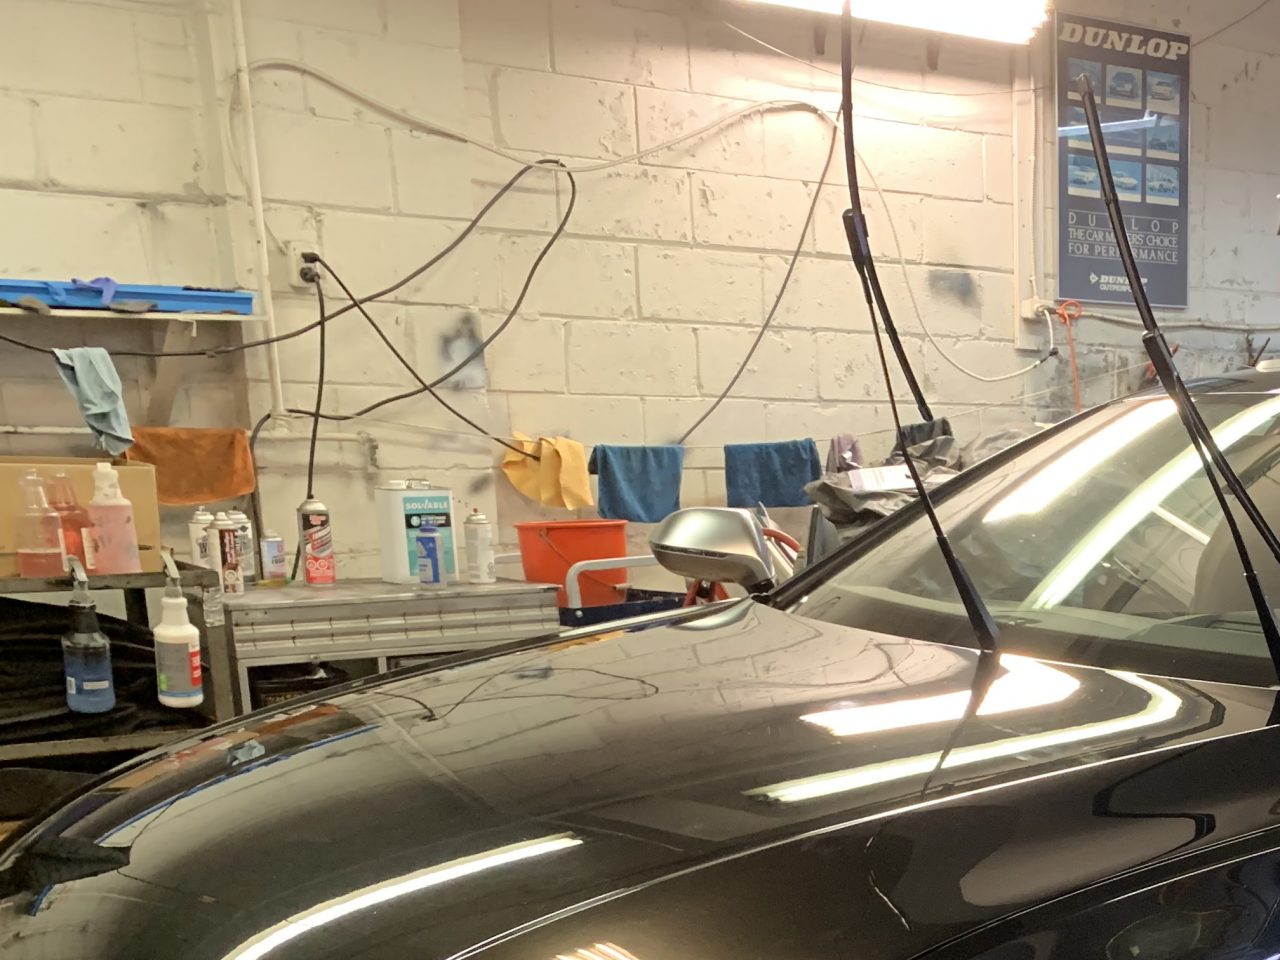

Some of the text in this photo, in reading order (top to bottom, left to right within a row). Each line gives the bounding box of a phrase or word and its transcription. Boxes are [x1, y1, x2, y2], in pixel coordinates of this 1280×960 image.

[1059, 22, 1188, 60] DUNLOP
[1068, 212, 1179, 233] DULOP
[1068, 228, 1085, 241] THE
[1086, 230, 1104, 242] CAR
[1146, 235, 1178, 248] CHOICE
[1068, 242, 1089, 255] FOR
